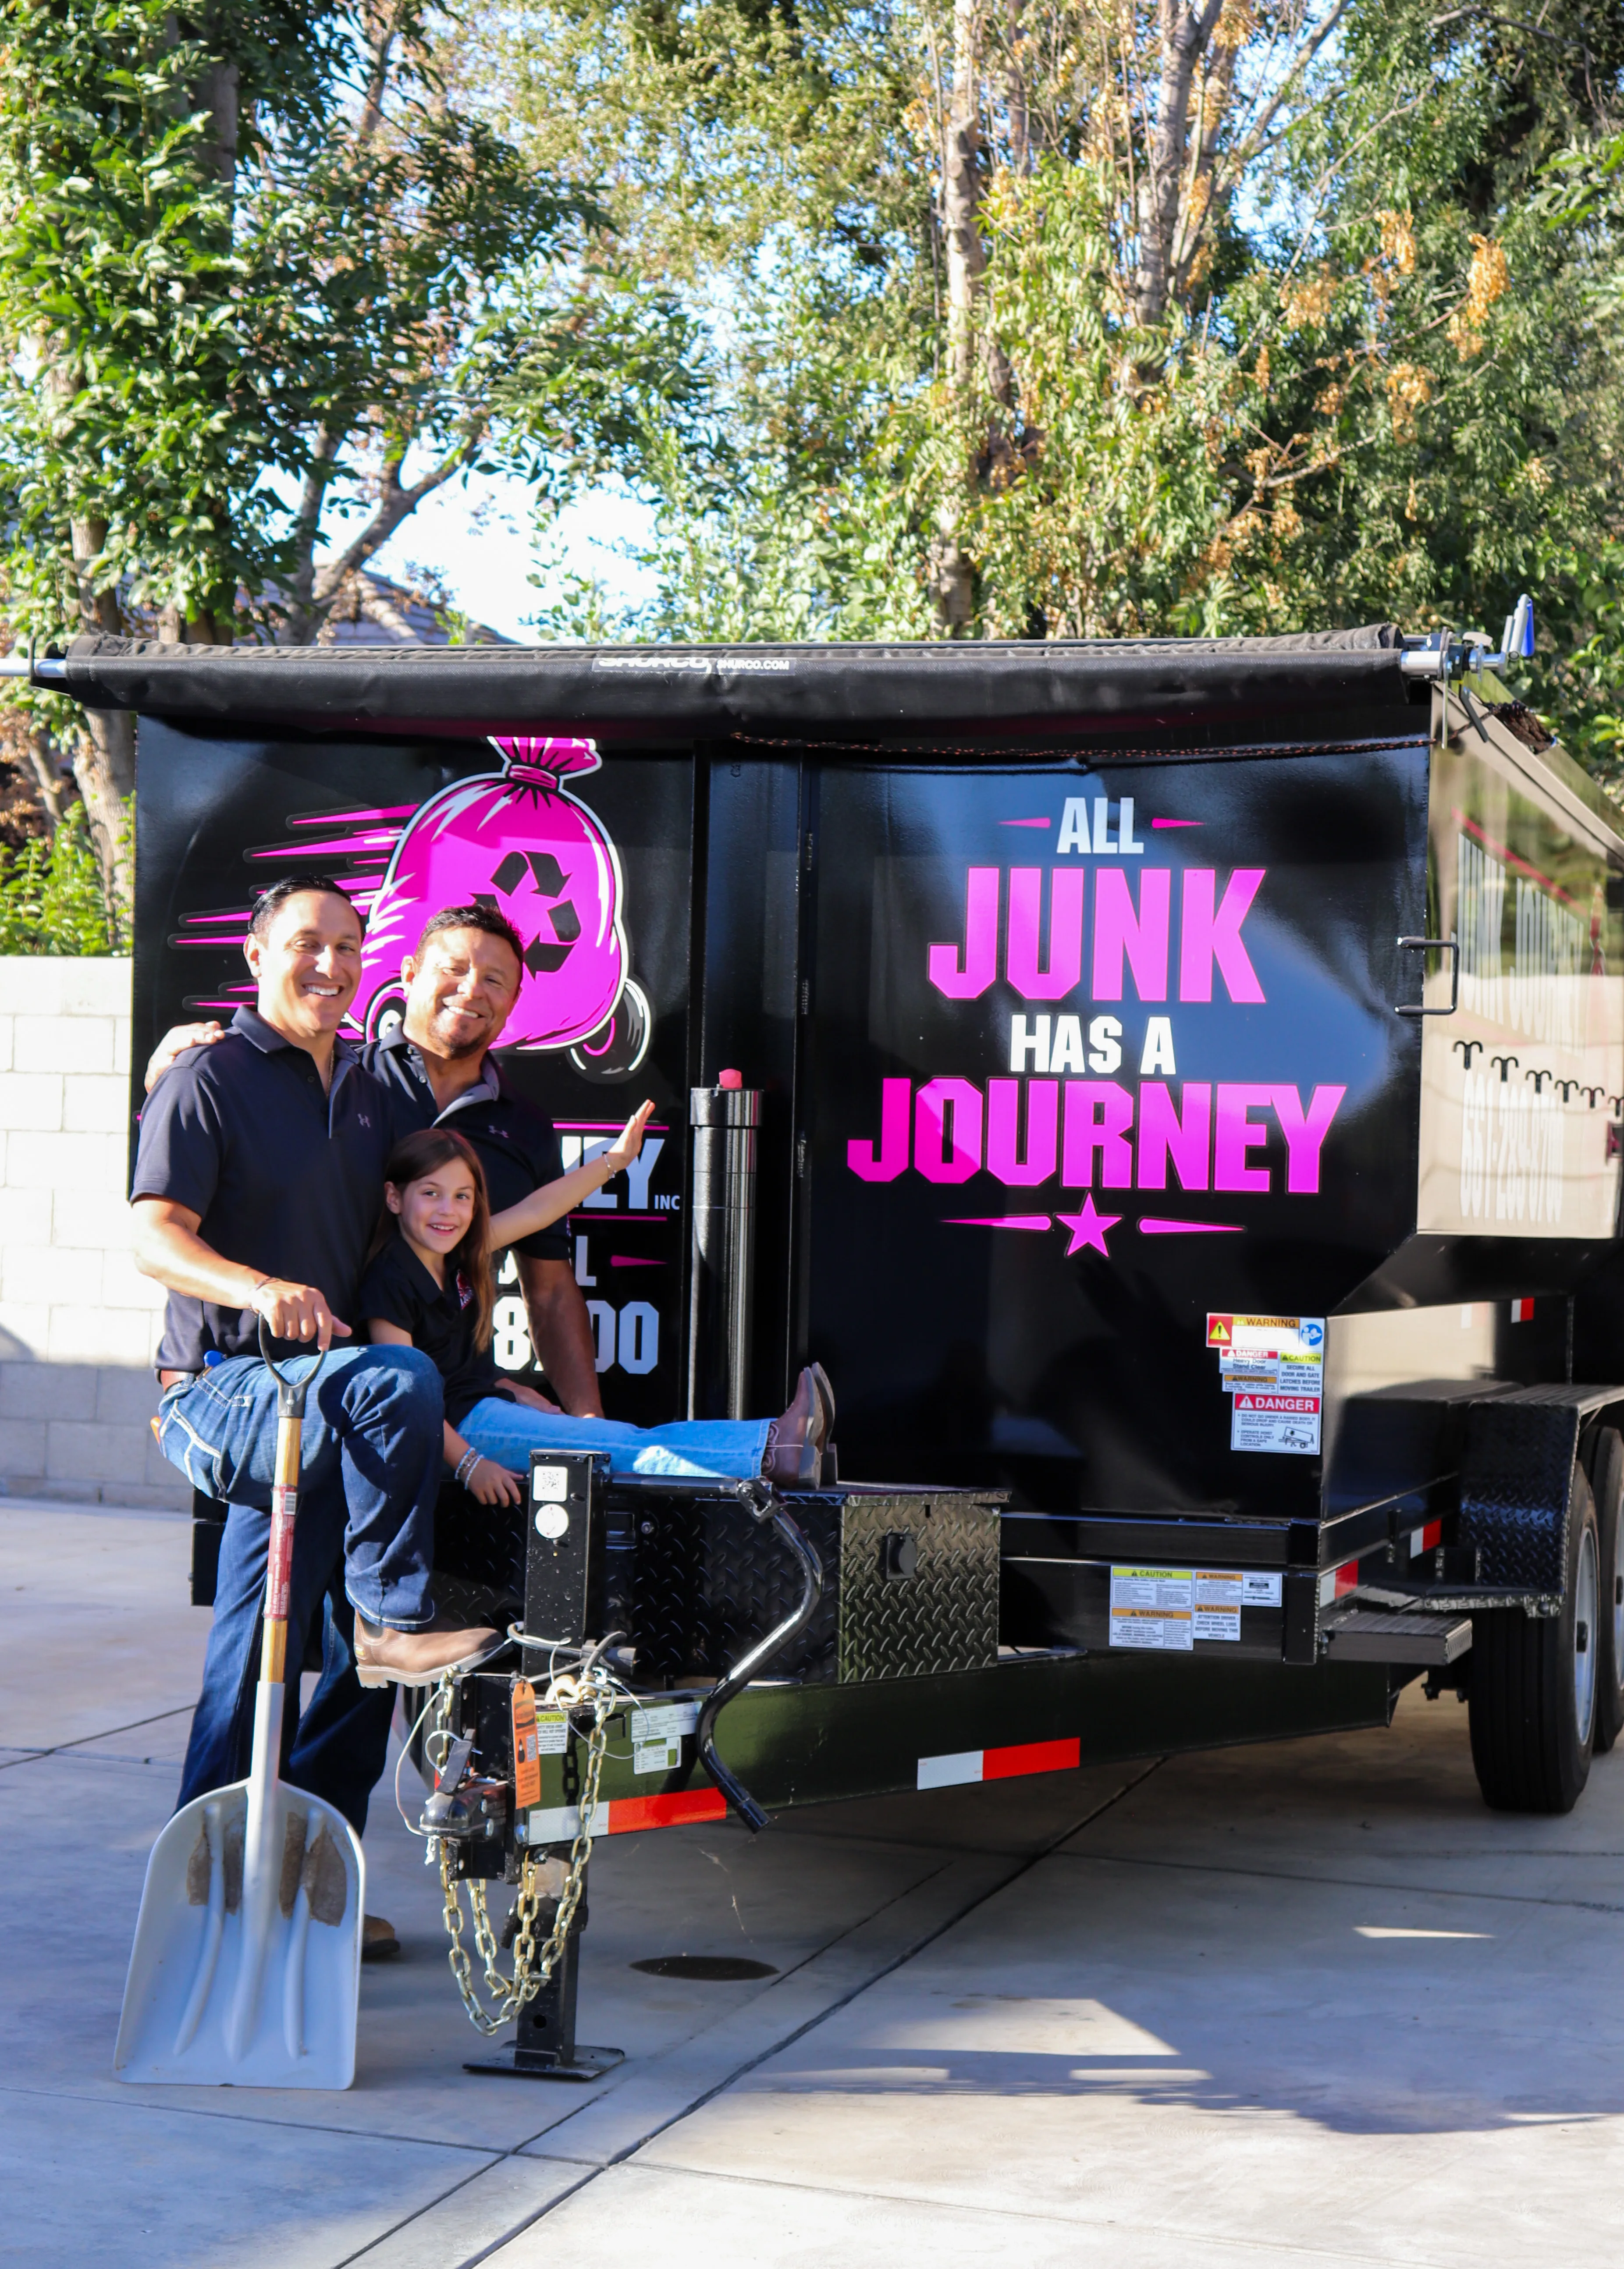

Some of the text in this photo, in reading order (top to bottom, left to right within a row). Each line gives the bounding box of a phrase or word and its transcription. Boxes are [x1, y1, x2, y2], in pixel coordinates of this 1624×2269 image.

[717, 660, 789, 670] SHURCO.COM
[1057, 797, 1144, 854] ALL
[927, 867, 1267, 1003] JUNK
[1010, 1015, 1176, 1075] HAS A
[847, 1078, 1347, 1193] JOURNEY
[654, 1195, 680, 1210] INC
[1247, 1317, 1296, 1328] WARNING
[1255, 1397, 1314, 1411] DANGER
[540, 1714, 565, 1722] CAUTION
